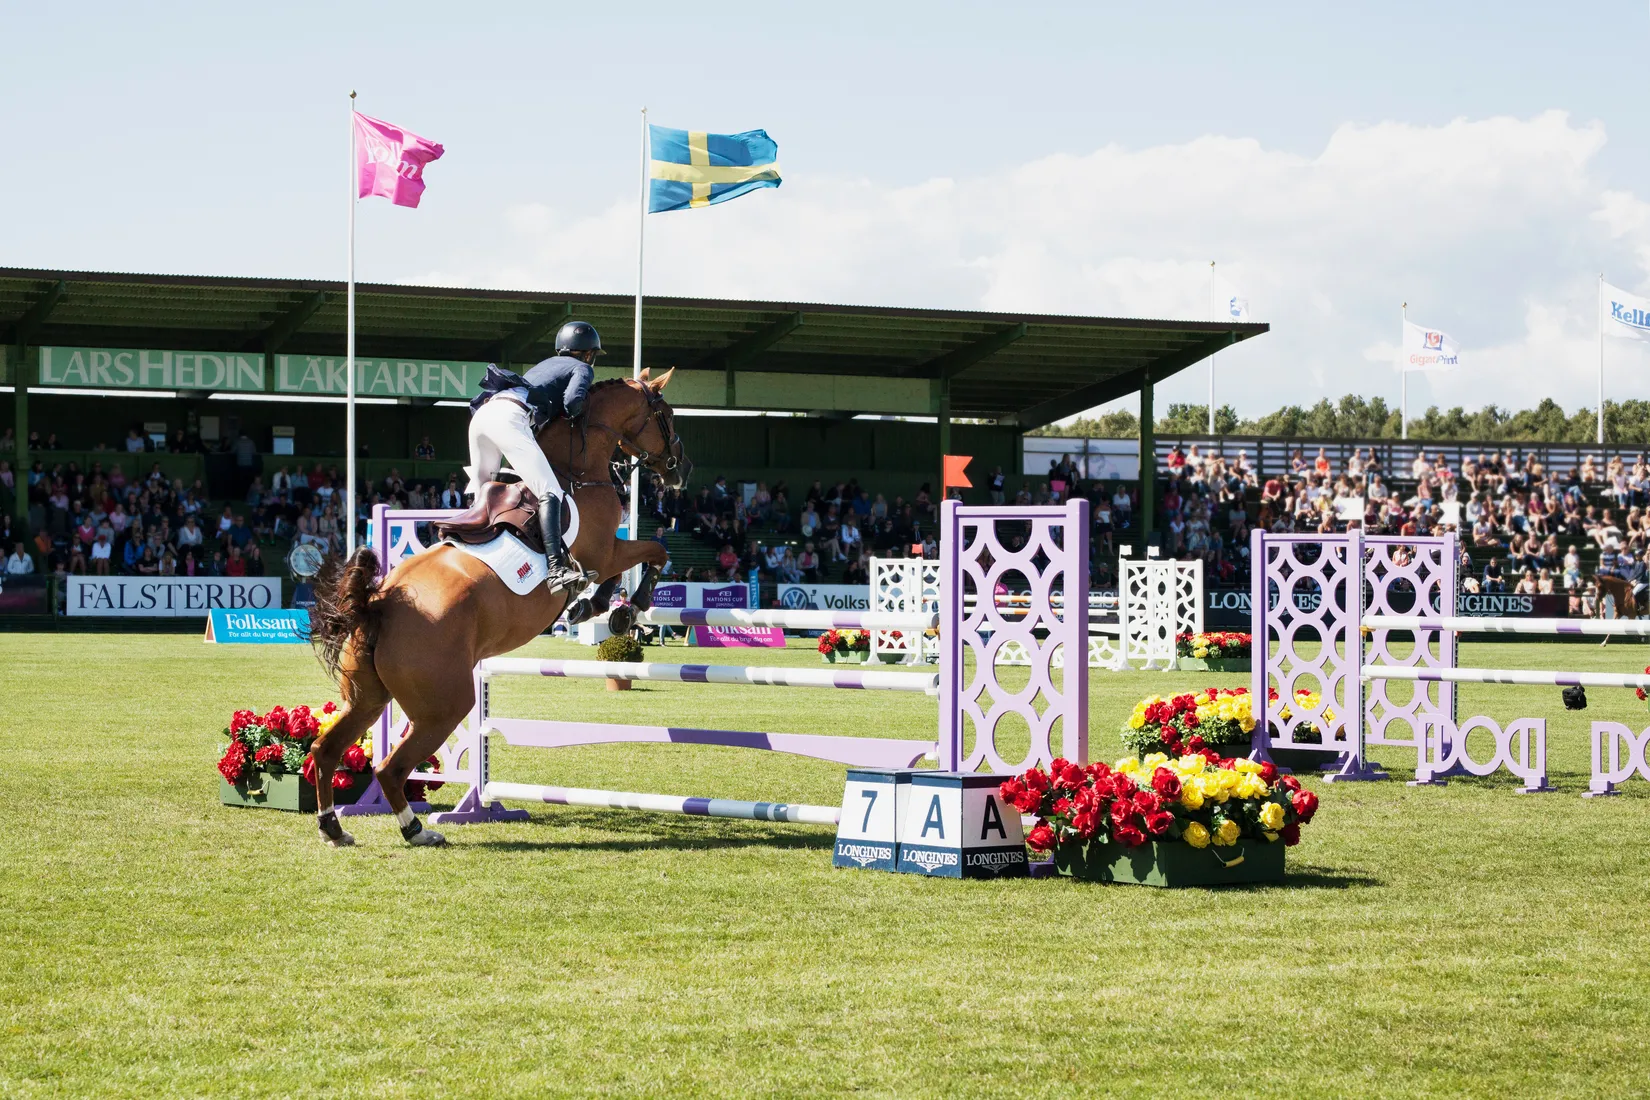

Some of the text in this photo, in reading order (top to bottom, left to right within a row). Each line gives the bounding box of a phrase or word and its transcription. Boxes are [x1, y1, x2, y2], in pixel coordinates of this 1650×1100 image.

[279, 356, 467, 396] LÄKTAREN
[78, 583, 272, 609] FALSTERBO
[225, 614, 297, 629] Folksam
[861, 790, 878, 833] 7
[920, 794, 945, 839] A
[980, 794, 1007, 840] A
[838, 843, 892, 860] LONGINES
[903, 849, 958, 866] LONGINES
[966, 851, 1024, 866] LONGINES
